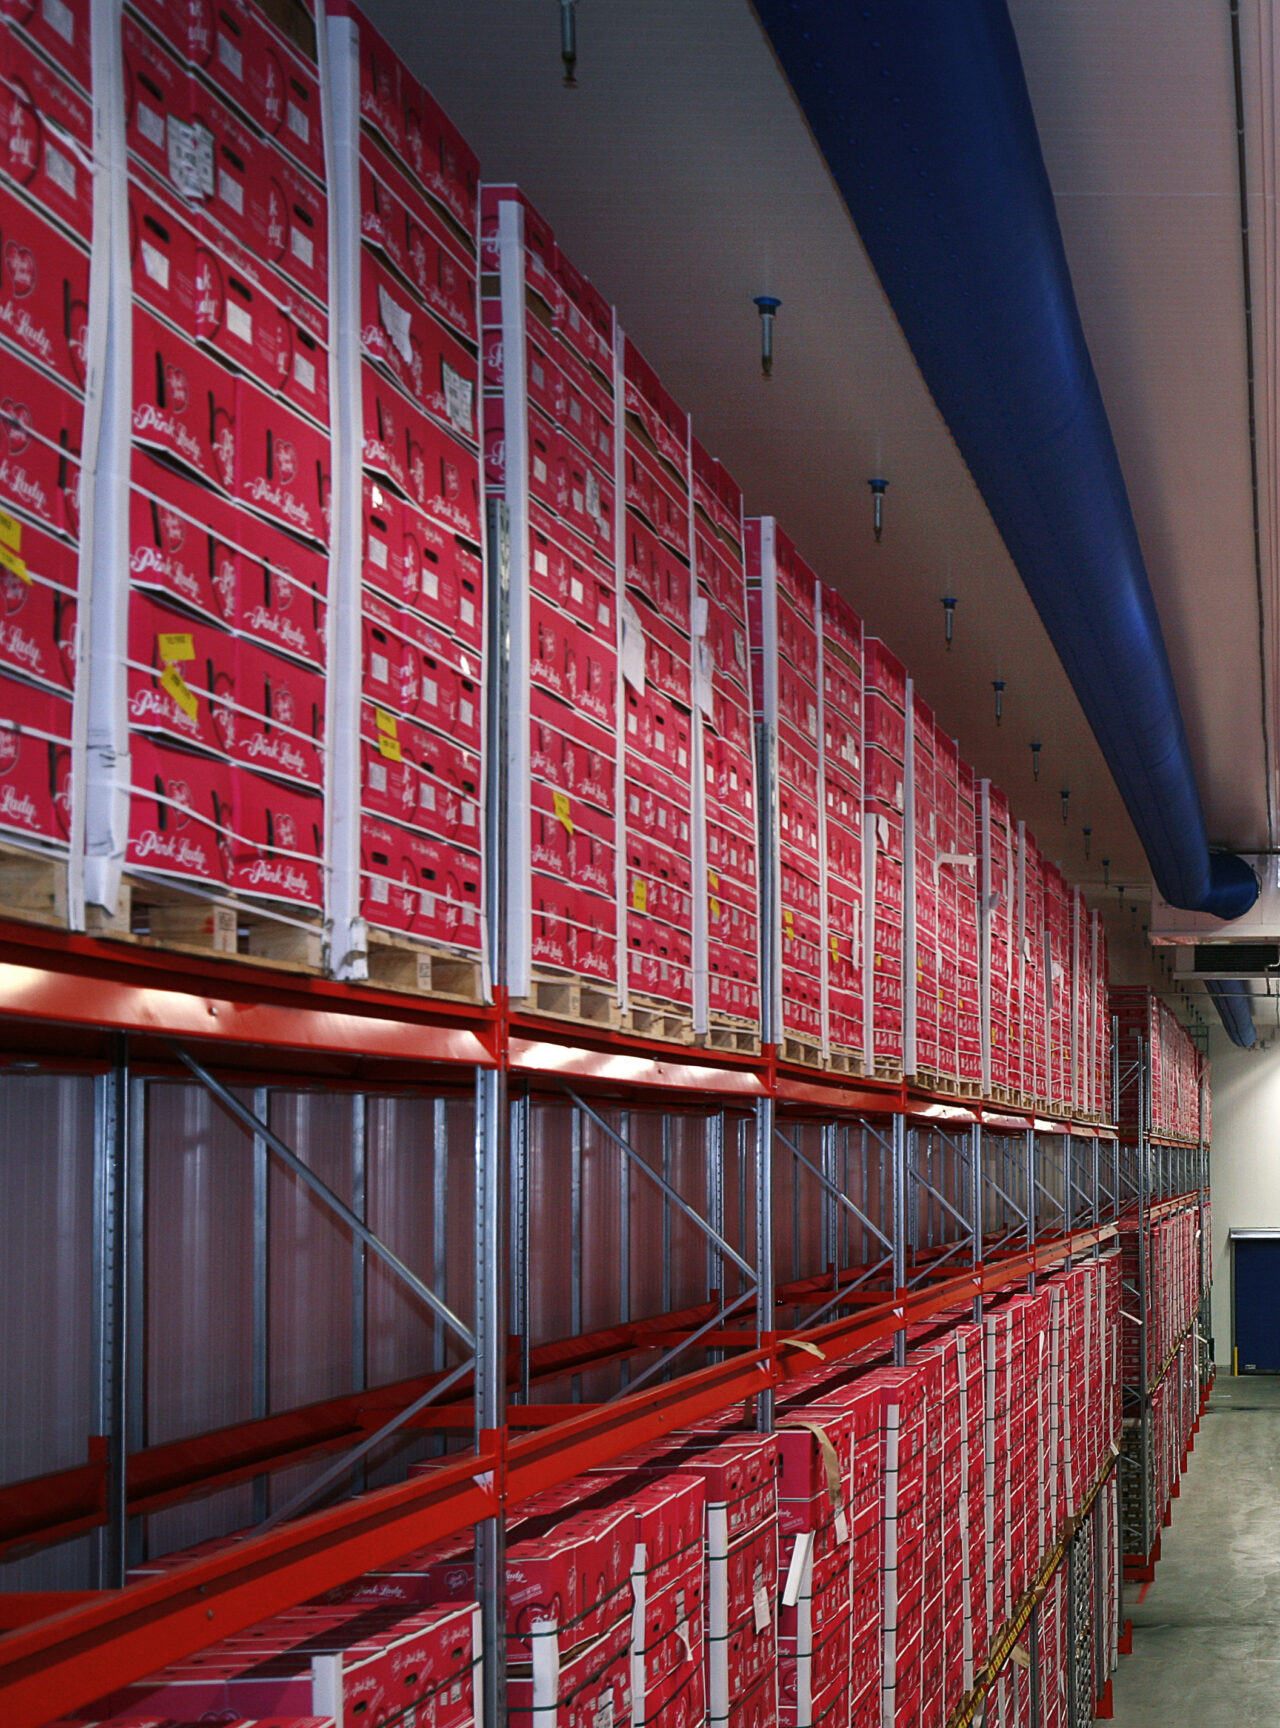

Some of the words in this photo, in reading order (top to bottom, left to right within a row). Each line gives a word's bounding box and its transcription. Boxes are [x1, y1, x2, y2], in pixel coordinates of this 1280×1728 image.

[131, 402, 175, 434] Pink
[172, 428, 206, 468] Lady
[243, 475, 284, 506] Pink
[281, 490, 315, 533] Lady
[242, 605, 284, 635] Pink
[280, 618, 312, 656] Lady
[239, 732, 281, 758] Pink
[277, 745, 310, 779] Lady
[126, 829, 178, 858] Pink
[174, 836, 210, 875] Lady
[239, 860, 282, 886] Pink
[276, 869, 313, 901] Lady
